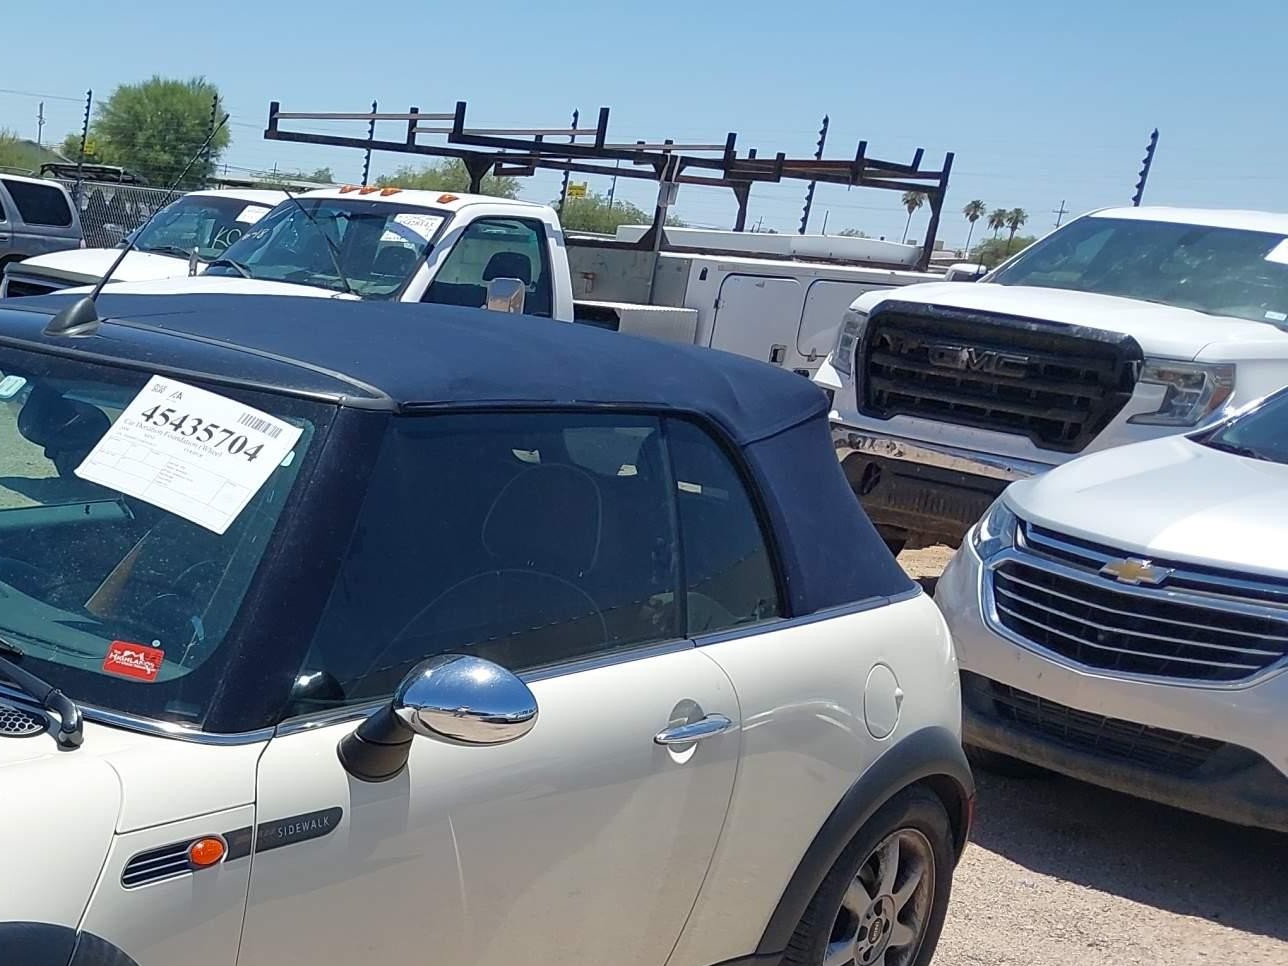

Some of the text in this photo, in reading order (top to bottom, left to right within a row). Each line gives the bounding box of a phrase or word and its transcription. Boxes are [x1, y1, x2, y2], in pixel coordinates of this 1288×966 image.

[928, 345, 1029, 378] GMC
[141, 404, 265, 462] 45435704
[278, 816, 330, 838] SIDEWALK
